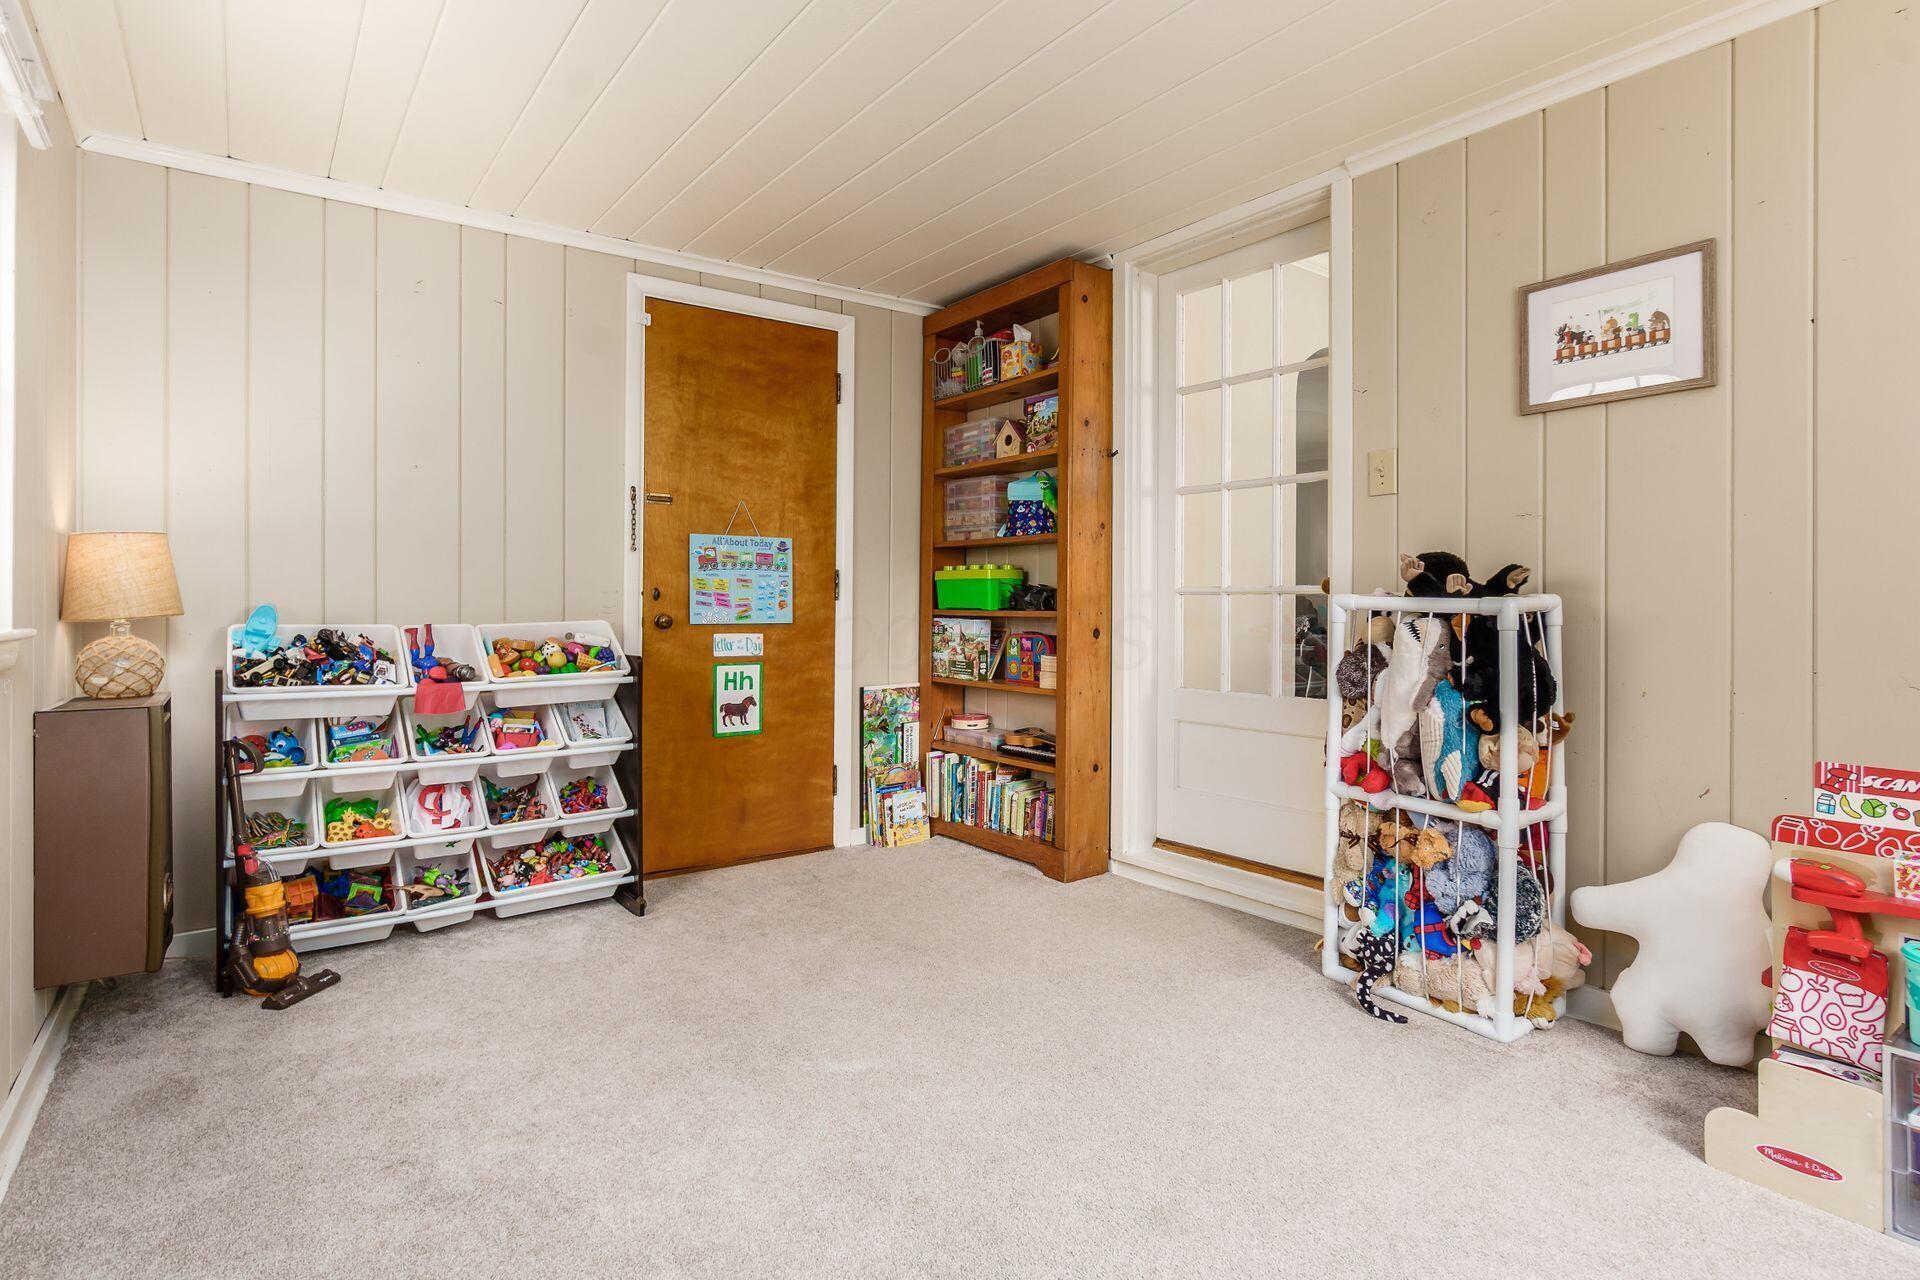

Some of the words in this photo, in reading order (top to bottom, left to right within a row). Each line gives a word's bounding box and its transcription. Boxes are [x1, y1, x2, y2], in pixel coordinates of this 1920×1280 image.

[723, 537, 748, 547] About
[750, 539, 773, 550] Today
[724, 671, 753, 691] Hh
[1858, 775, 1920, 793] SCAN
[1763, 1146, 1802, 1166] Melissa
